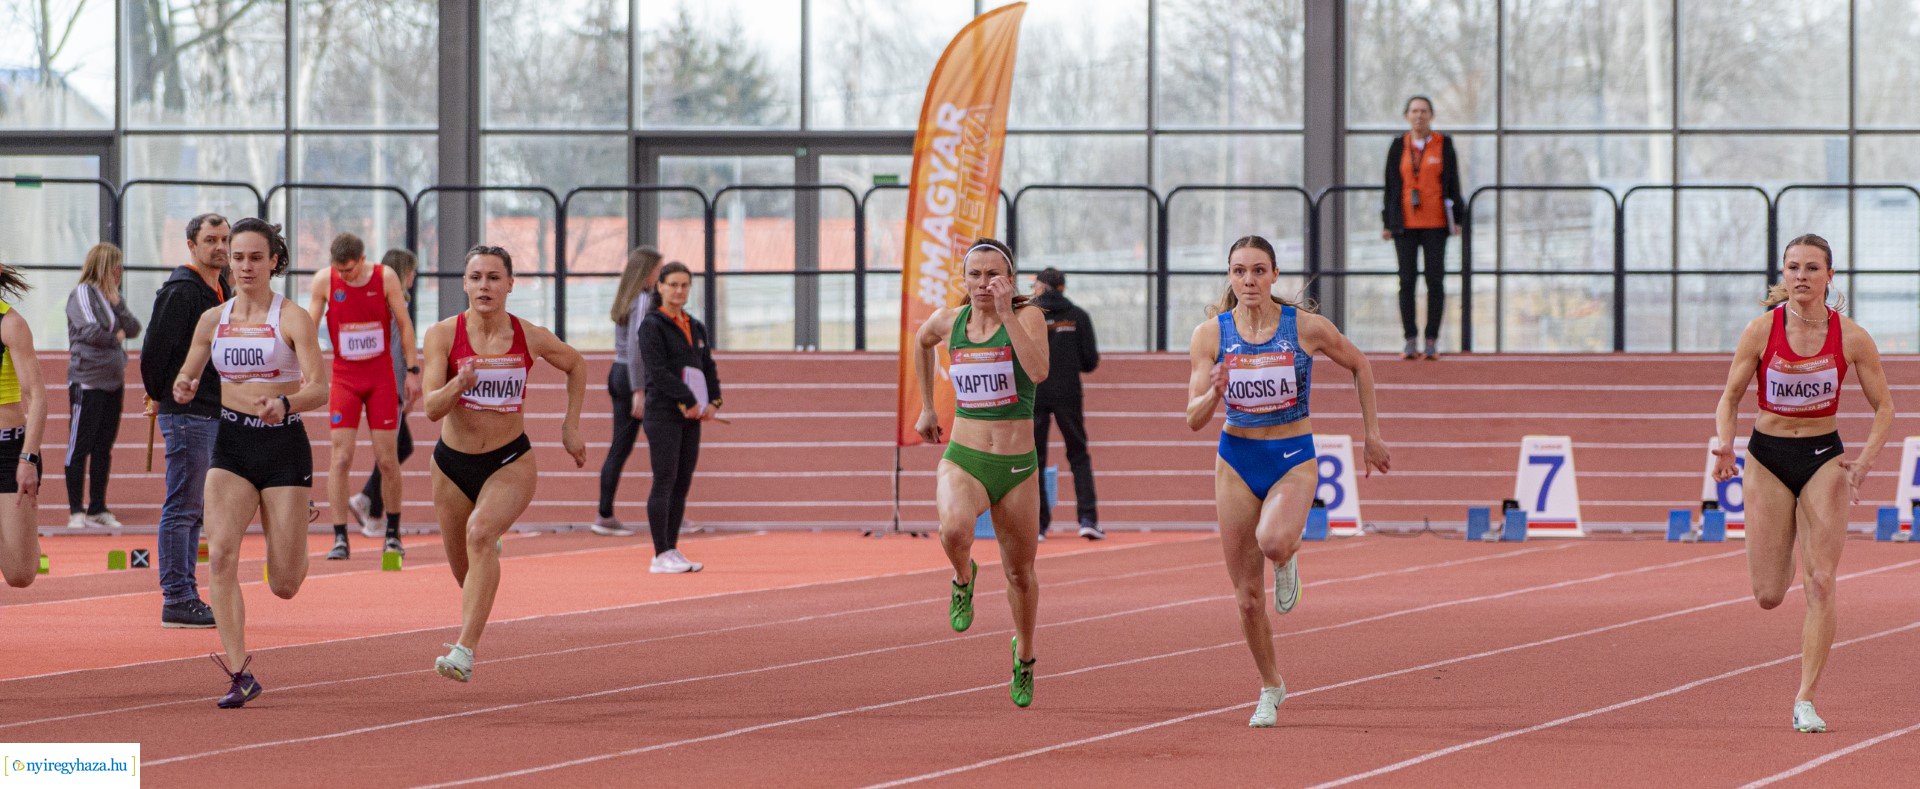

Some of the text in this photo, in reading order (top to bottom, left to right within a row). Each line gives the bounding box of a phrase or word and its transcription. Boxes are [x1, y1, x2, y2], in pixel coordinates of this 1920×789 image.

[918, 102, 967, 308] #MAGYAR
[348, 336, 378, 351] ÖTVÖS
[224, 348, 266, 366] FODOR
[956, 373, 1009, 393] KAPTUR
[1228, 378, 1294, 399] KOCSIS A.
[1770, 381, 1820, 398] TAKÁCS
[1315, 454, 1345, 511] 8
[1528, 455, 1565, 512] 7
